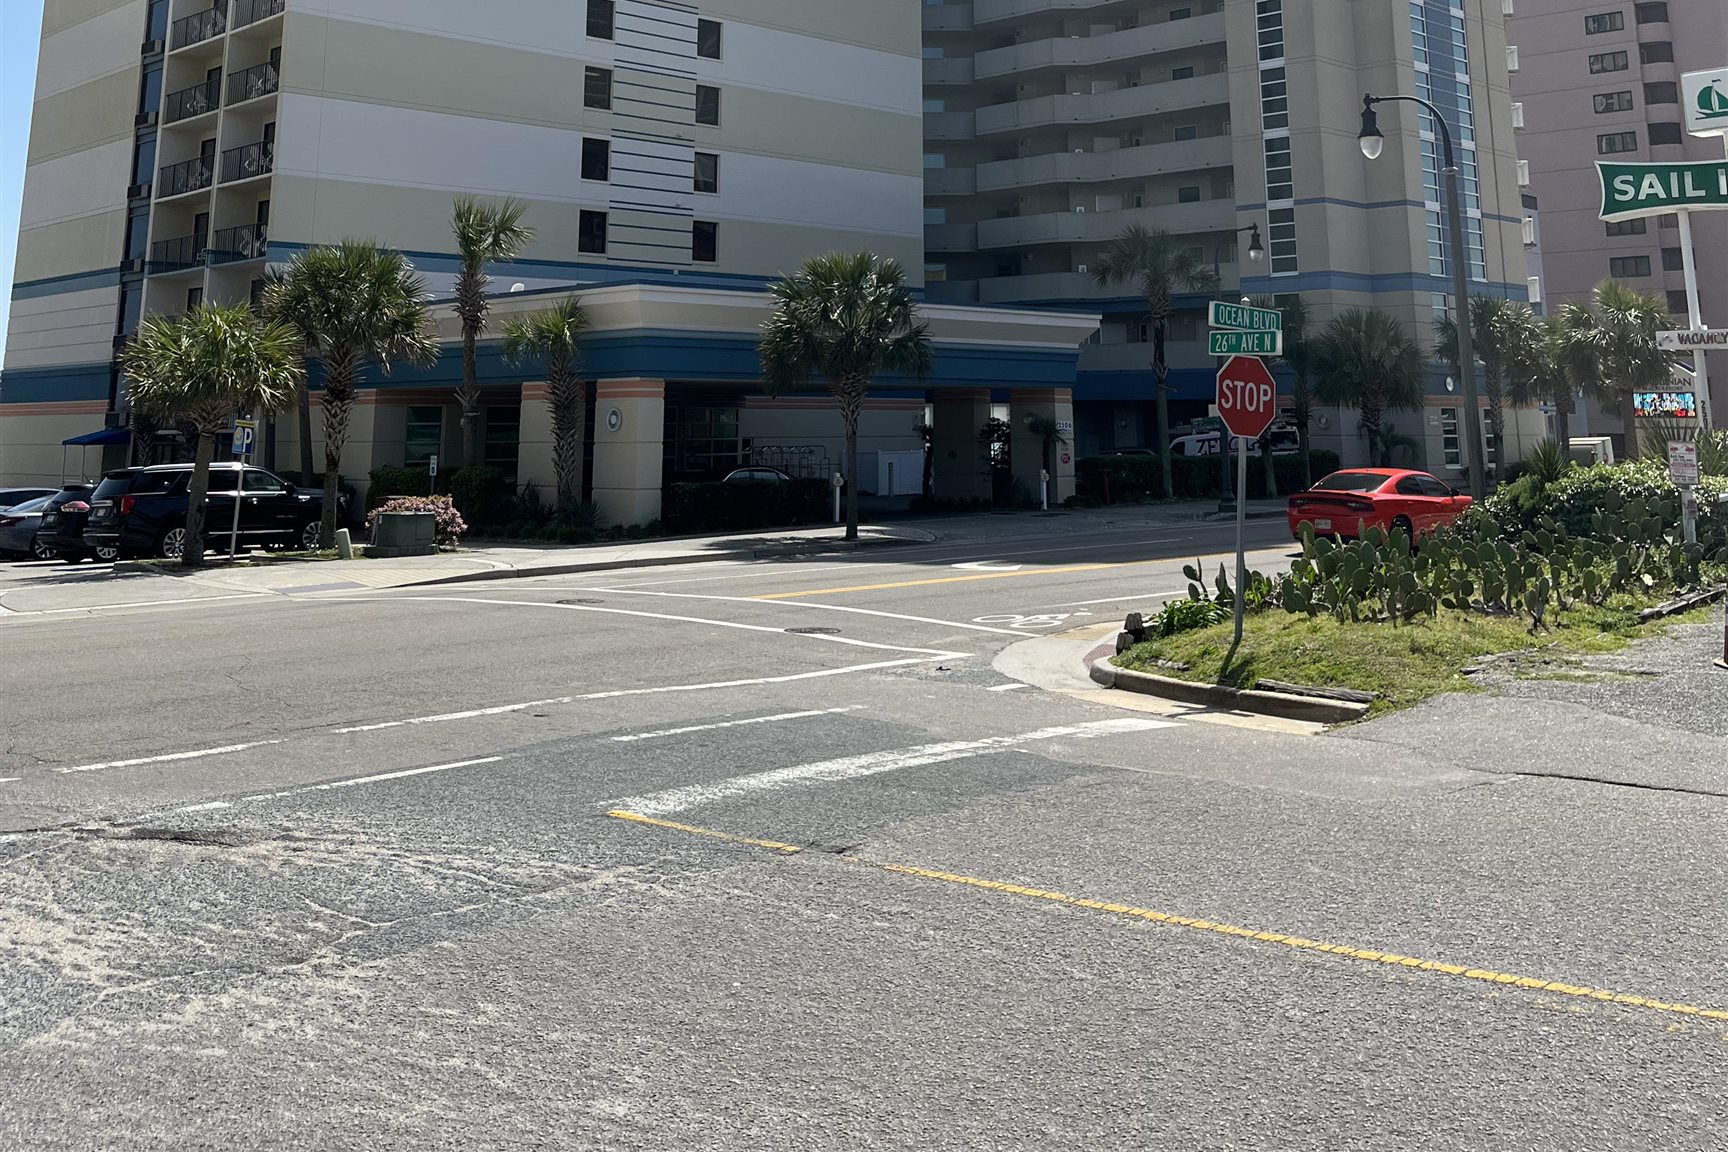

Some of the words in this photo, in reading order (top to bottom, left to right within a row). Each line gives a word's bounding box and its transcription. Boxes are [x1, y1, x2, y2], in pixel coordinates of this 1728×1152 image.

[1613, 170, 1706, 202] SAIL
[1219, 305, 1249, 328] OCEAN
[1253, 311, 1277, 330] BLVD
[1215, 334, 1236, 352] 26TH
[1240, 333, 1260, 352] AVE
[1264, 333, 1271, 351] N
[1677, 332, 1728, 344] VACANCY
[1221, 379, 1272, 412] STOP
[243, 428, 253, 453] P
